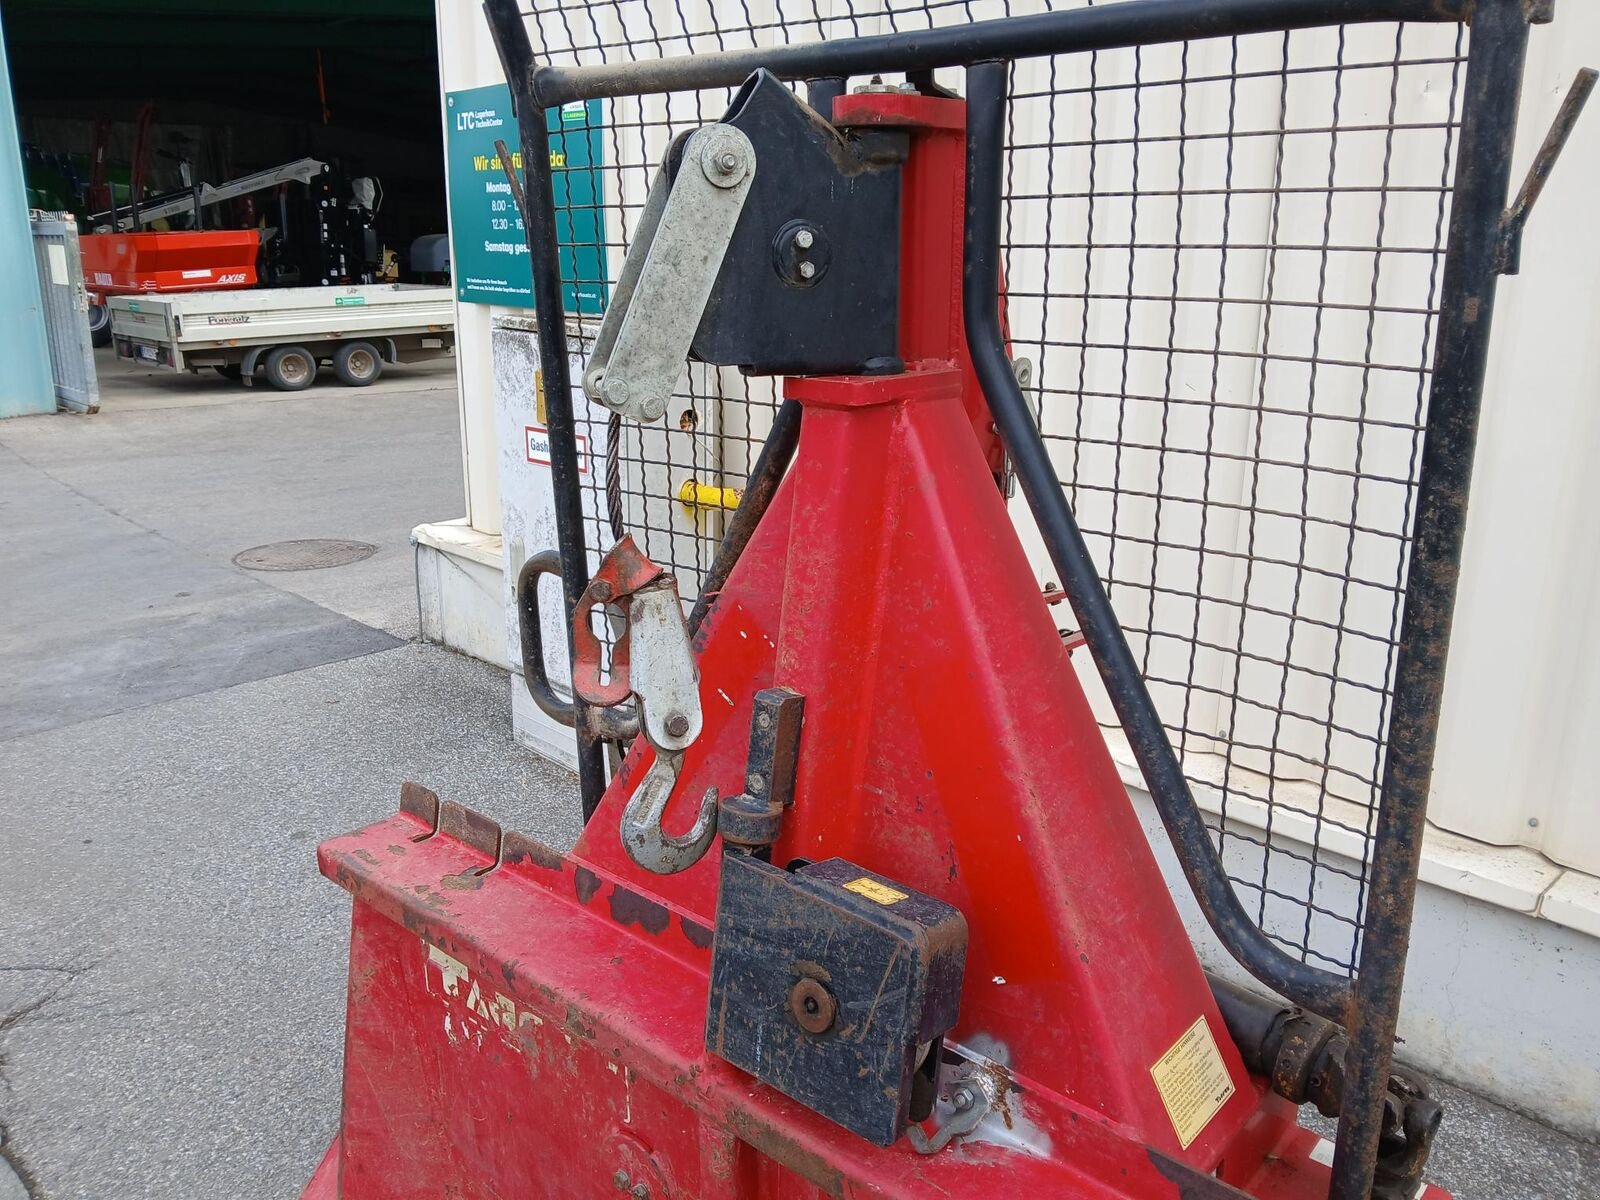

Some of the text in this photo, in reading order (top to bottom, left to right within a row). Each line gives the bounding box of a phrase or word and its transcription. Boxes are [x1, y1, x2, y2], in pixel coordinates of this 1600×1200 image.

[457, 112, 474, 130] LTC
[473, 154, 488, 171] Wir
[491, 153, 503, 169] sin
[512, 152, 522, 168] fü
[486, 182, 511, 194] Montag
[491, 200, 505, 211] 8.00
[492, 219, 508, 230] 12.30
[485, 240, 513, 255] Samstag
[217, 273, 246, 283] AXIS
